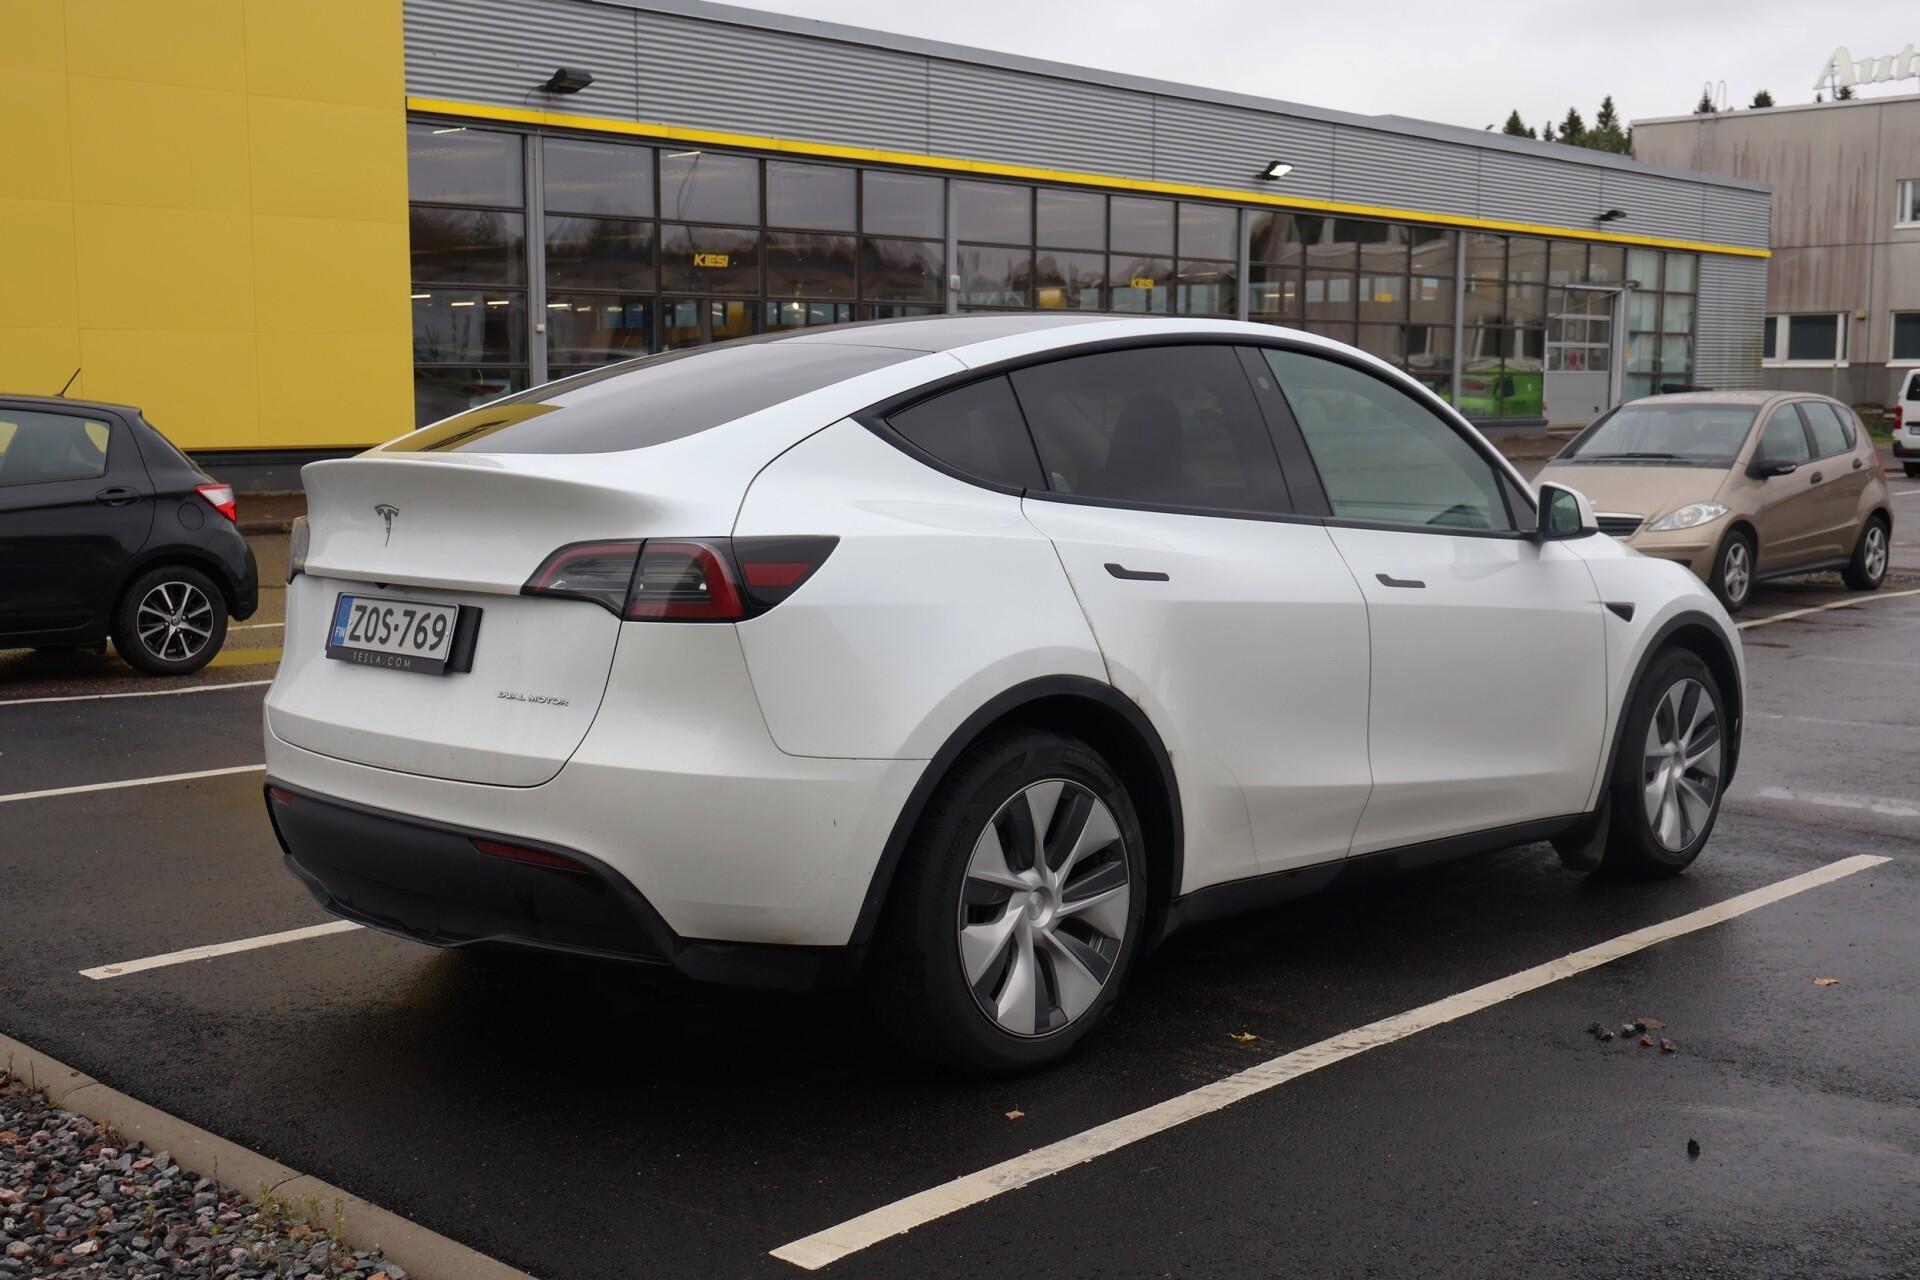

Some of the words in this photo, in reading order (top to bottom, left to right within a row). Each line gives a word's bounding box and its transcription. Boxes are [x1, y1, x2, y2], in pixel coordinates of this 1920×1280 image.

[694, 253, 729, 268] KIESI
[334, 626, 346, 638] FIN
[348, 604, 447, 651] ZOS-769
[352, 651, 411, 668] TESLA.COM
[497, 691, 526, 702] DUAL
[528, 695, 569, 707] MOTOR
